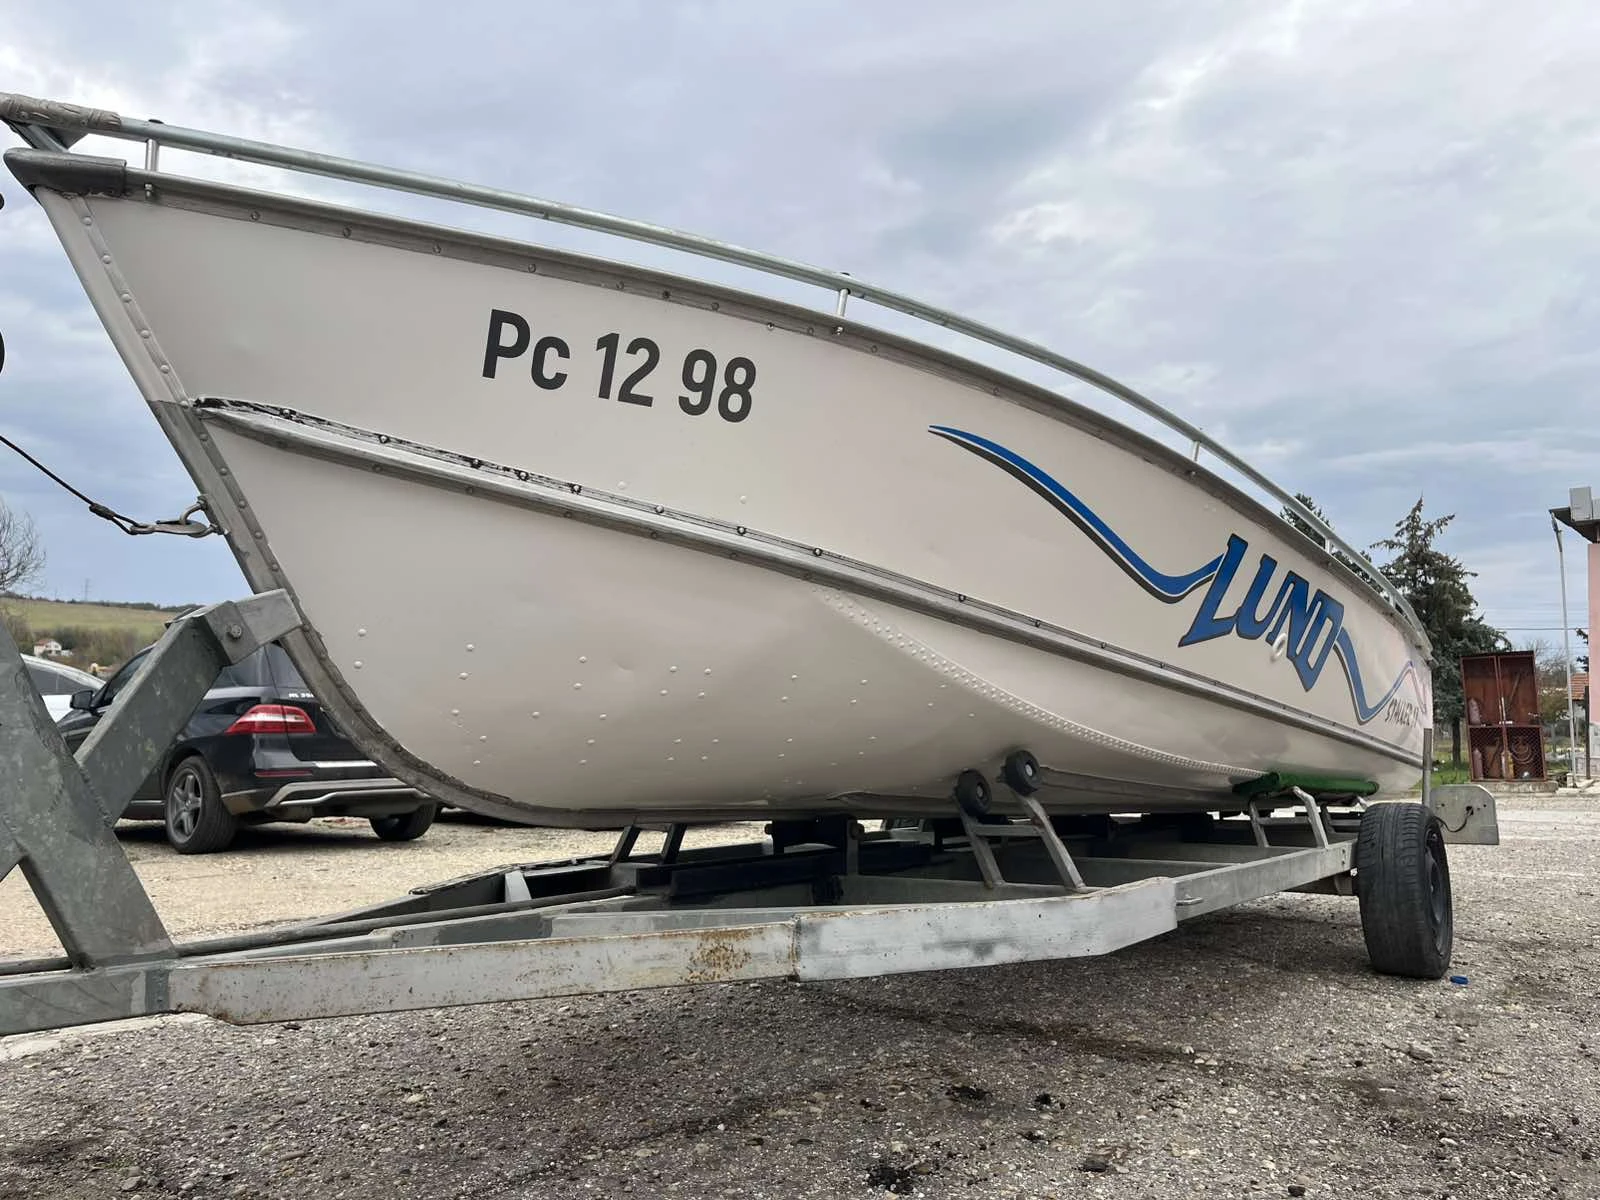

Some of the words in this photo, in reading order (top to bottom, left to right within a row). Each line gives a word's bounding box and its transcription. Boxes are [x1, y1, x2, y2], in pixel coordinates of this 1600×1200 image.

[595, 332, 661, 408] 12
[678, 348, 757, 424] 98
[1177, 532, 1345, 693] LUND
